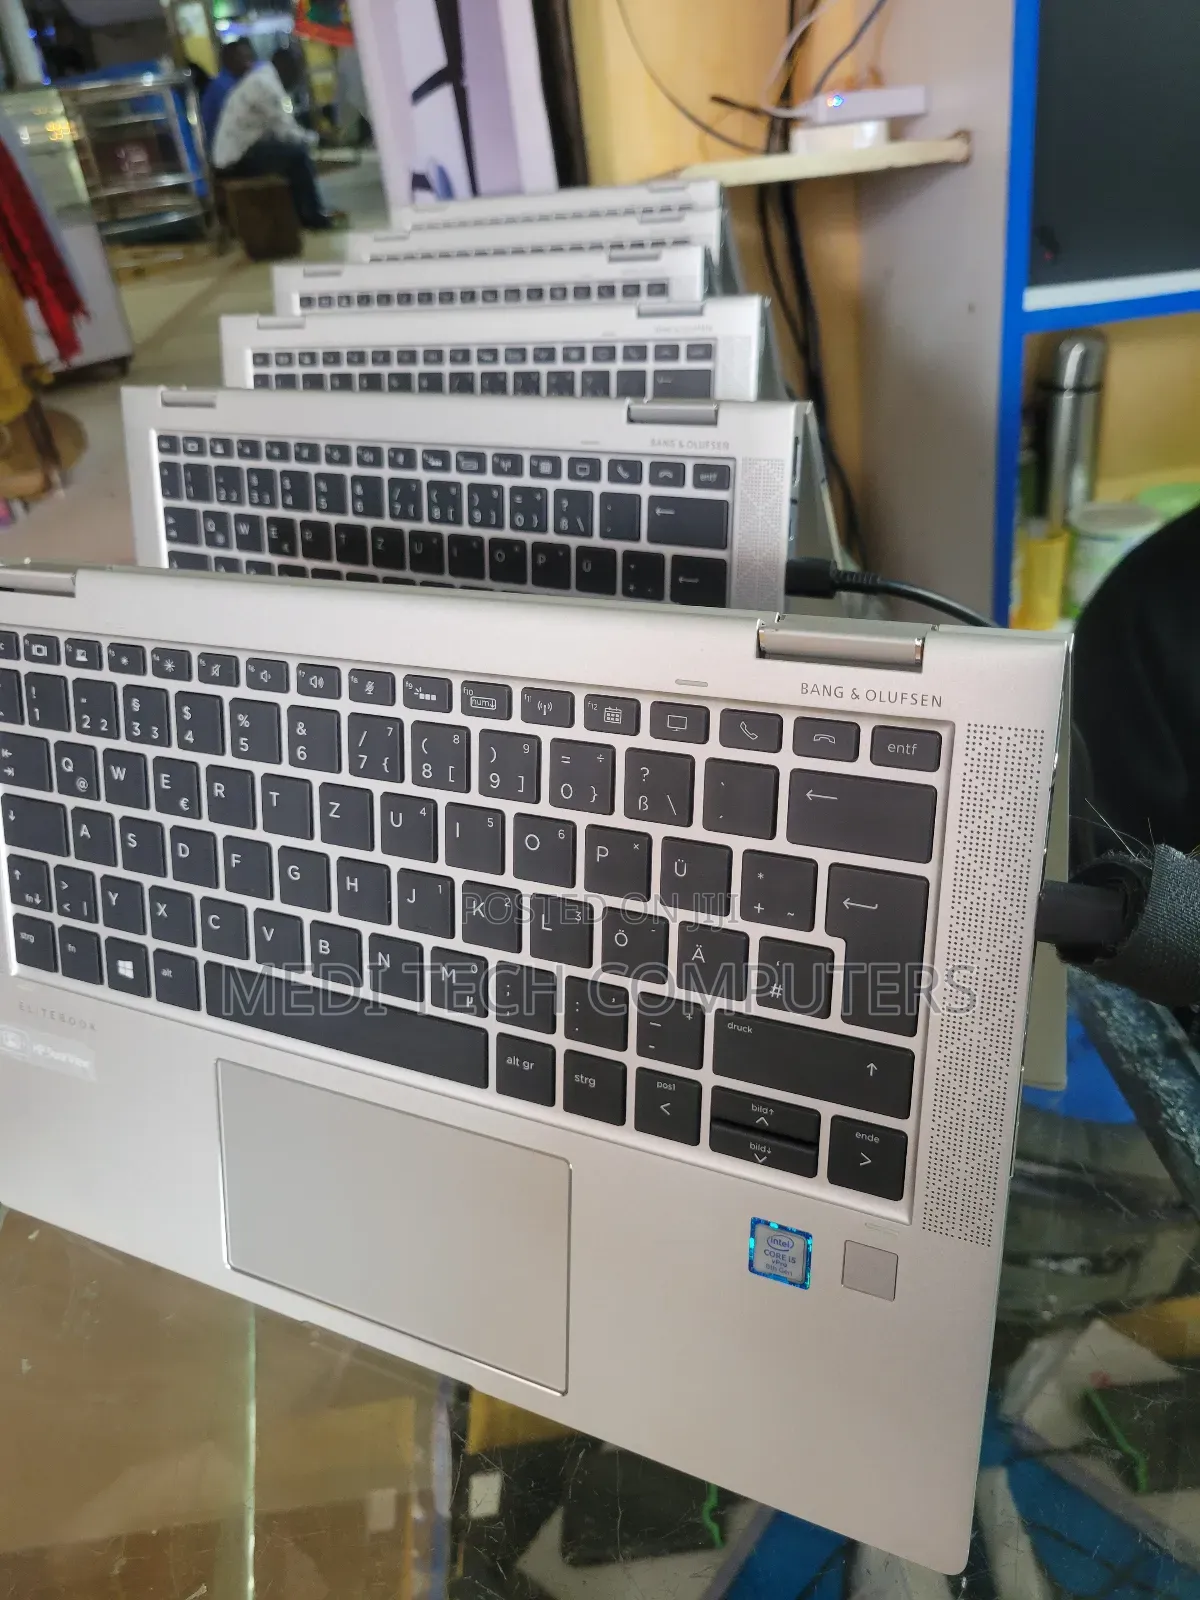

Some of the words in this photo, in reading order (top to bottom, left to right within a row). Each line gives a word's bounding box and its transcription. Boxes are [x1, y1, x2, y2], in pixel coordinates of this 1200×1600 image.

[237, 522, 250, 536] W
[406, 681, 413, 689] f9
[463, 686, 475, 696] f10
[801, 682, 843, 700] BANG
[851, 687, 861, 701] &
[866, 688, 942, 709] OLUFSEN
[132, 698, 140, 711] §
[588, 701, 597, 710] f12
[34, 708, 39, 720] 1
[183, 706, 191, 720] $
[83, 715, 90, 728] 2
[101, 719, 108, 731] 2
[238, 714, 249, 727] %
[133, 722, 140, 736] 3
[152, 727, 158, 738] 3
[296, 722, 306, 735] &
[387, 727, 393, 736] 7
[185, 731, 194, 743] 4
[359, 731, 367, 746] /
[453, 735, 459, 744] 8
[240, 738, 248, 751] 5
[422, 738, 427, 754] (
[523, 744, 529, 753] 9
[887, 743, 918, 756] entf
[297, 746, 307, 760] 6
[491, 747, 496, 763] )
[62, 757, 73, 772] Q
[359, 755, 367, 769] 7
[383, 757, 389, 772] {
[111, 766, 126, 780] W
[422, 763, 432, 778] 8
[449, 766, 454, 782] [
[641, 767, 649, 782] ?
[76, 777, 88, 792] @
[161, 774, 171, 789] E
[490, 773, 500, 788] 9
[518, 776, 524, 792] ]
[214, 783, 225, 797] R
[561, 784, 572, 799] 0
[590, 786, 597, 802] }
[180, 798, 189, 810] €
[269, 792, 279, 806] T
[639, 796, 648, 810] ß
[667, 795, 676, 815] \
[329, 802, 340, 818] Z
[420, 807, 426, 816] 4
[391, 811, 402, 827] U
[80, 824, 90, 838] A
[559, 830, 565, 839] 6
[128, 833, 137, 847] S
[525, 834, 540, 850] O
[178, 843, 189, 857] D
[596, 846, 609, 862] P
[232, 854, 241, 867] F
[675, 859, 686, 876] Ü
[288, 866, 300, 880] G
[61, 881, 68, 889] >
[347, 876, 358, 892] H
[109, 891, 118, 905] Y
[407, 889, 415, 903] J
[157, 903, 167, 917] X
[472, 901, 484, 917] K
[754, 903, 764, 913] +
[209, 915, 220, 929] C
[542, 914, 552, 931] L
[575, 911, 582, 922] 3
[19, 932, 35, 945] strg
[263, 927, 274, 941] V
[615, 929, 628, 946] Ö
[319, 940, 330, 954] B
[691, 944, 705, 964] Ä
[377, 952, 391, 968] N
[162, 969, 172, 977] alt
[441, 966, 456, 983] M
[471, 964, 477, 973] 0
[769, 983, 783, 998] #
[728, 1022, 752, 1033] druck
[507, 1056, 519, 1066] alt
[523, 1060, 535, 1072] gr
[574, 1073, 596, 1088] strg
[657, 1081, 676, 1093] pos1
[752, 1103, 770, 1114] bild
[856, 1131, 880, 1144] ende
[749, 1141, 768, 1152] bild
[769, 1236, 791, 1249] intel
[763, 1249, 787, 1262] CORE
[771, 1258, 788, 1268] vPro
[778, 1267, 793, 1277] Gen
